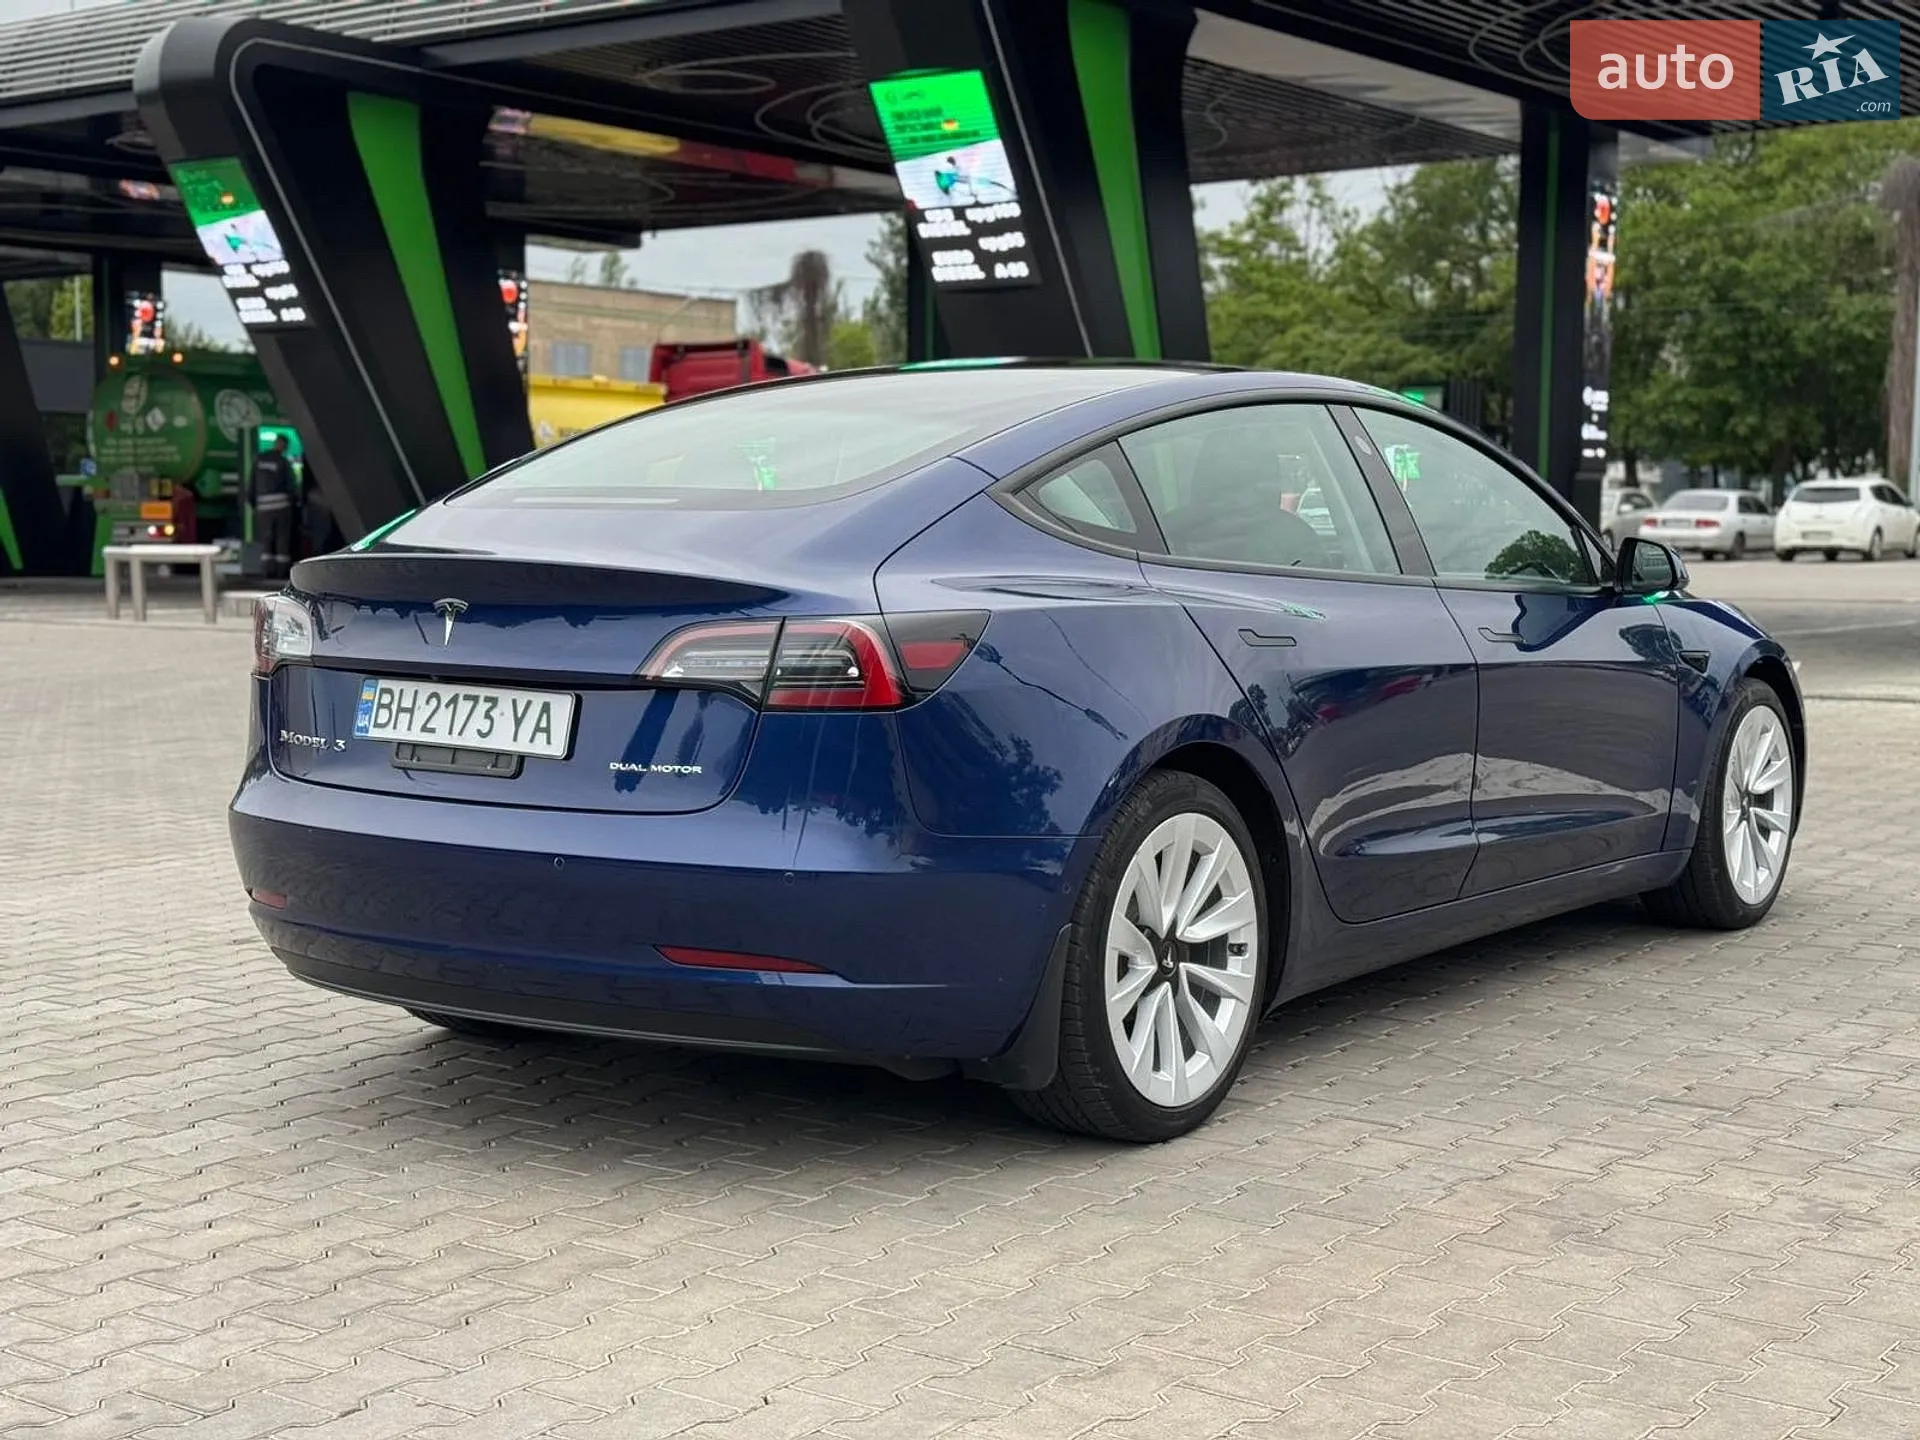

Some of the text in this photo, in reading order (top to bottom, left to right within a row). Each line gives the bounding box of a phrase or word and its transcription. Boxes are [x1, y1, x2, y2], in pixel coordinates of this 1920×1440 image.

[420, 691, 499, 739] 2173
[510, 697, 553, 746] YA
[333, 739, 346, 751] 3
[609, 762, 703, 774] DUAL MOTOR
